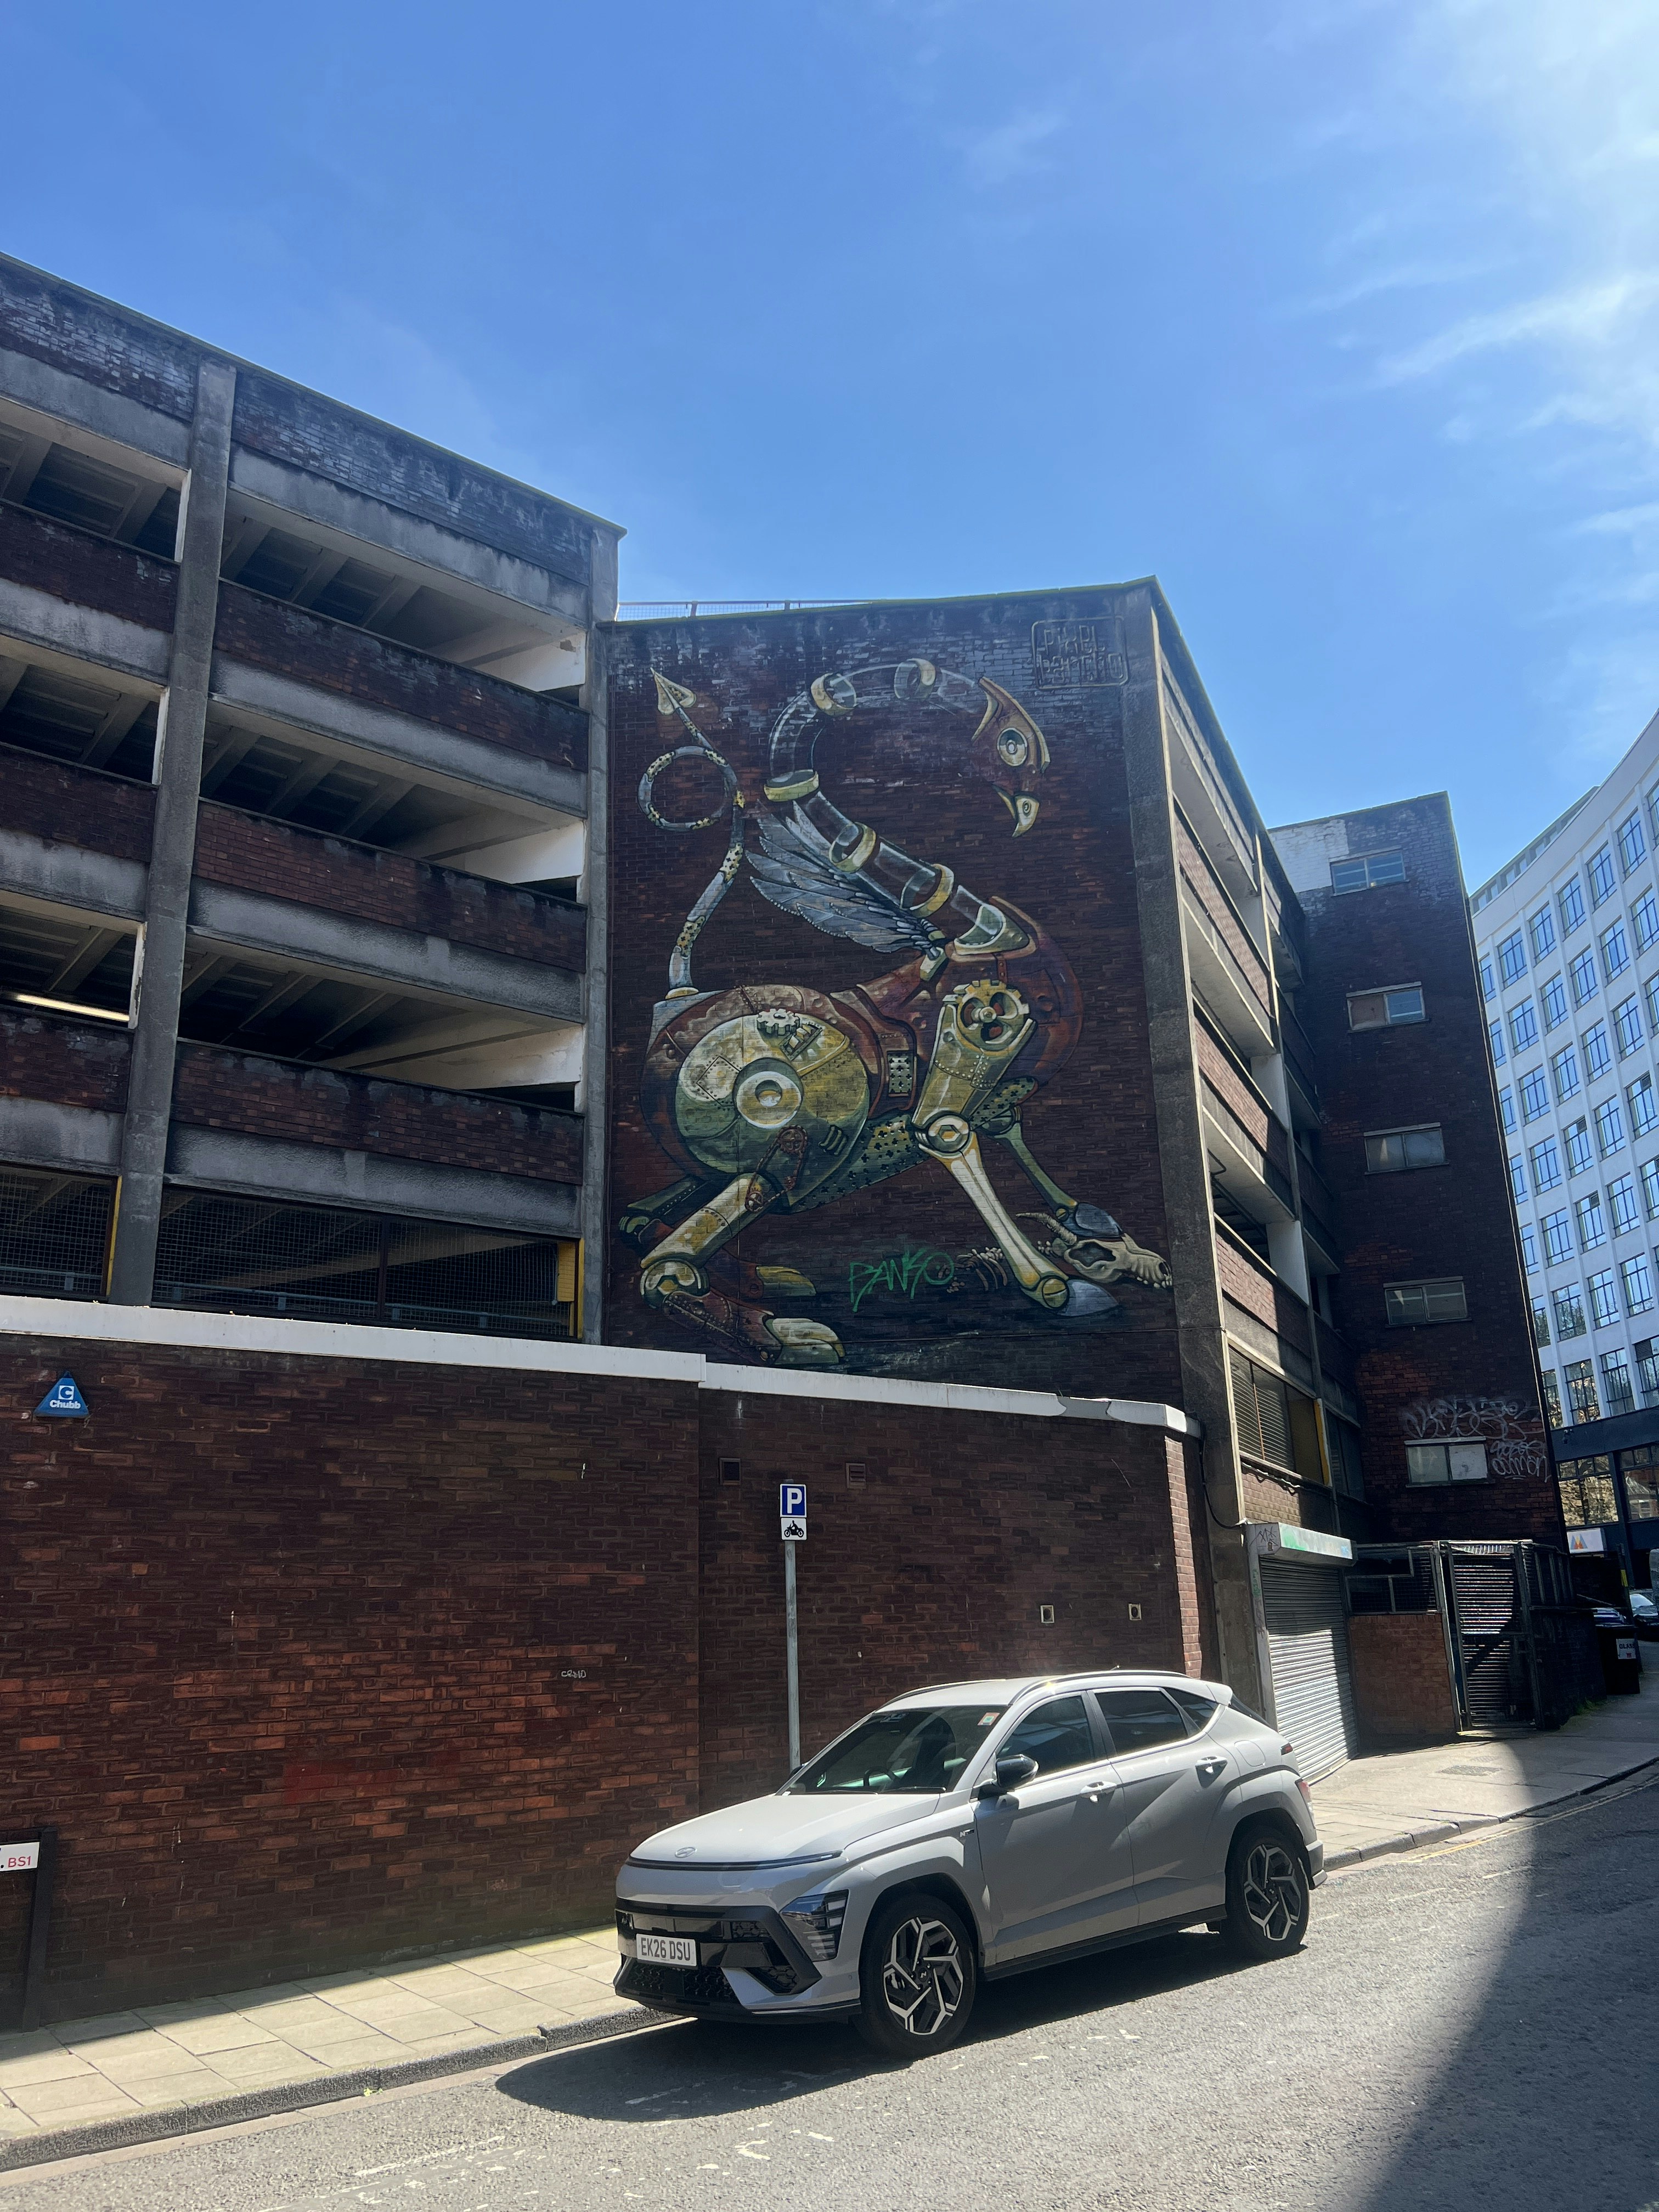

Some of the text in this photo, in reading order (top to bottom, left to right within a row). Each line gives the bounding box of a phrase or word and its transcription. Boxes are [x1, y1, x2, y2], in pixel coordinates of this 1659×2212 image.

[49, 1400, 81, 1409] Chubb
[787, 1487, 803, 1514] P
[8, 1855, 31, 1868] BS1
[641, 1937, 691, 1961] EK26 DSU
